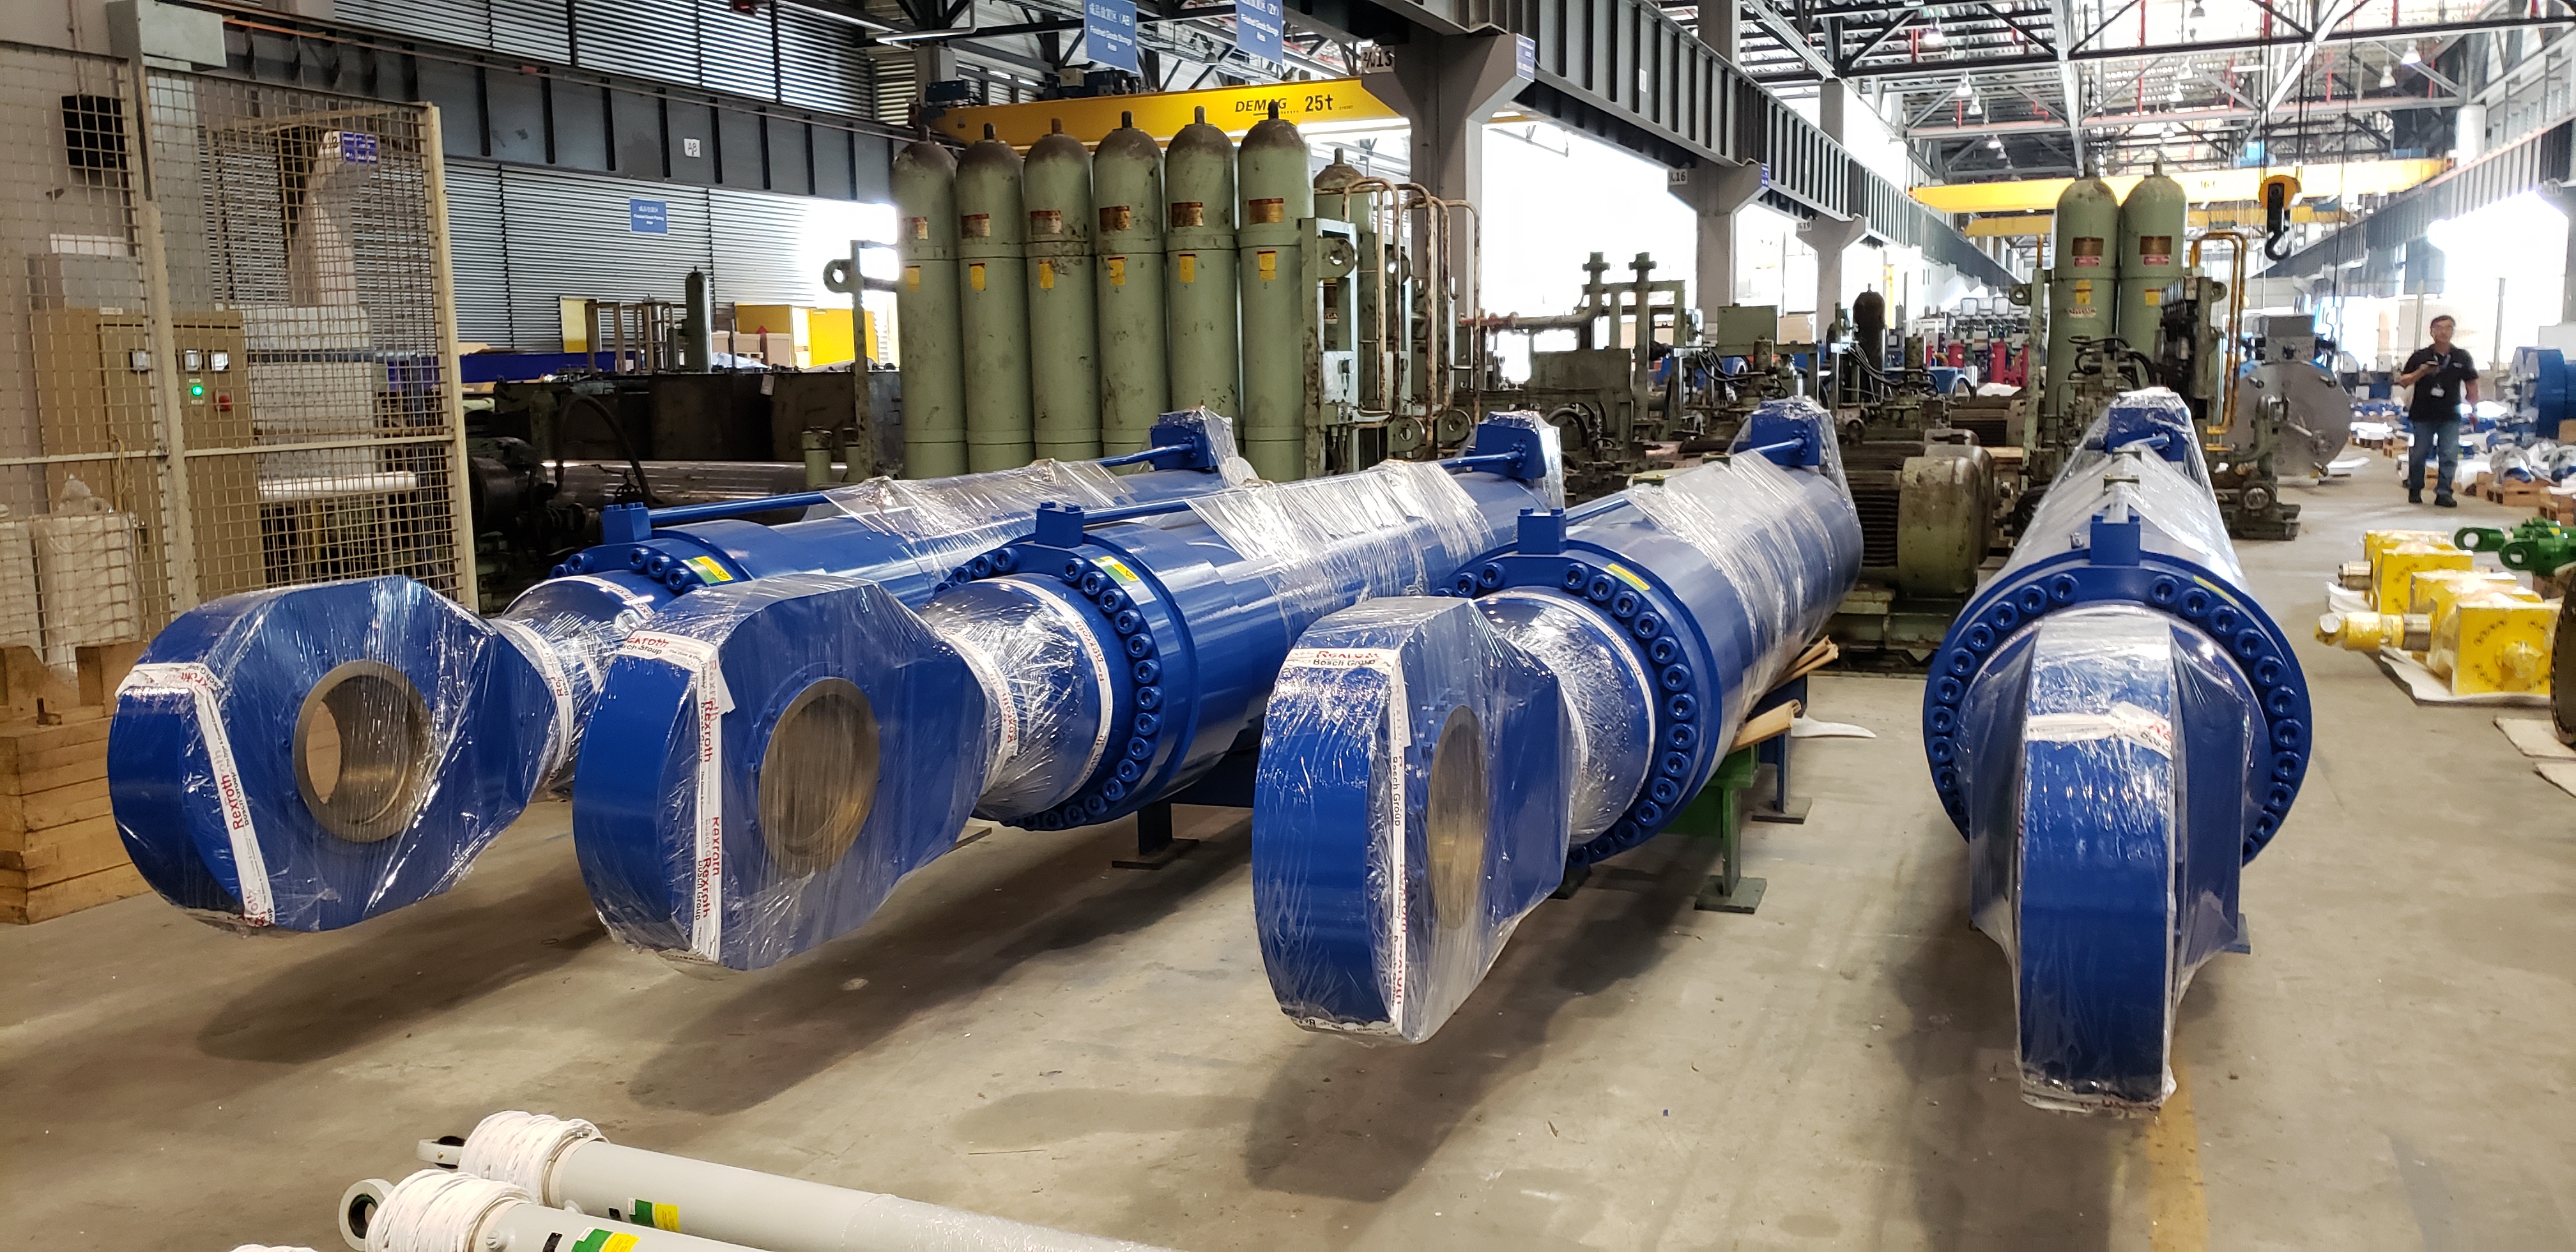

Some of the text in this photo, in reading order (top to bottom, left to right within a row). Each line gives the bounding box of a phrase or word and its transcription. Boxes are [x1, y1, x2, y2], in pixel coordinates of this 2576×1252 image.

[1305, 94, 1333, 112] 25t
[704, 700, 713, 763] Rexroth
[220, 774, 245, 830] Rexroth
[703, 857, 712, 919] Rexroth
